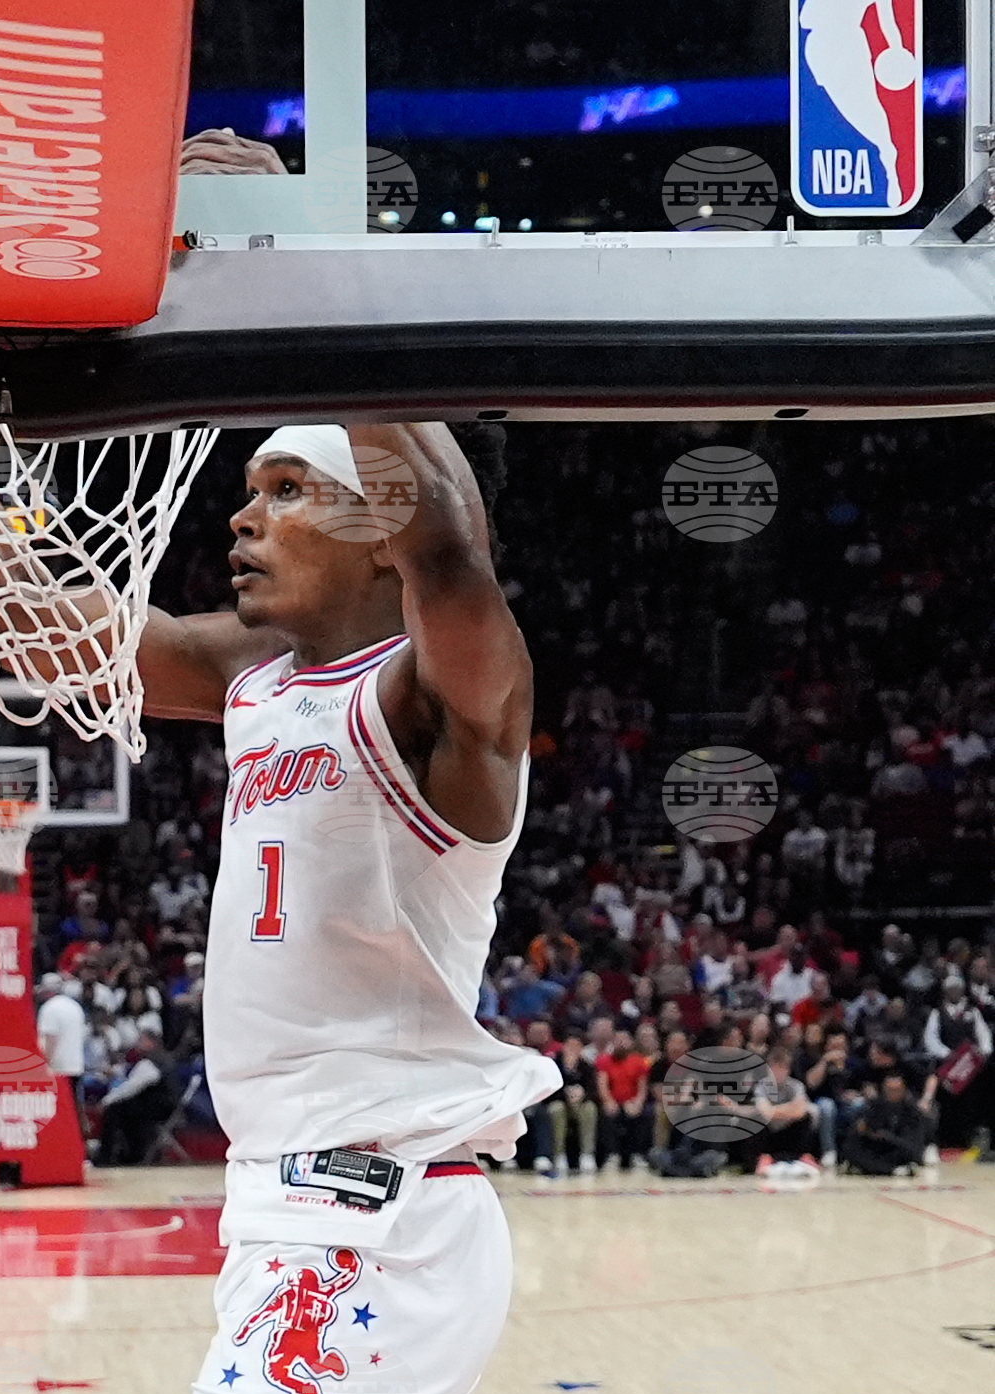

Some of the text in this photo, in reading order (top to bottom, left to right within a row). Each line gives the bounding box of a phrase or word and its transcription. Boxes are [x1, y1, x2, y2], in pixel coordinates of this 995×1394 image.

[812, 148, 873, 195] NBA
[250, 831, 287, 942] 1
[285, 1193, 337, 1208] HOMETOWN
